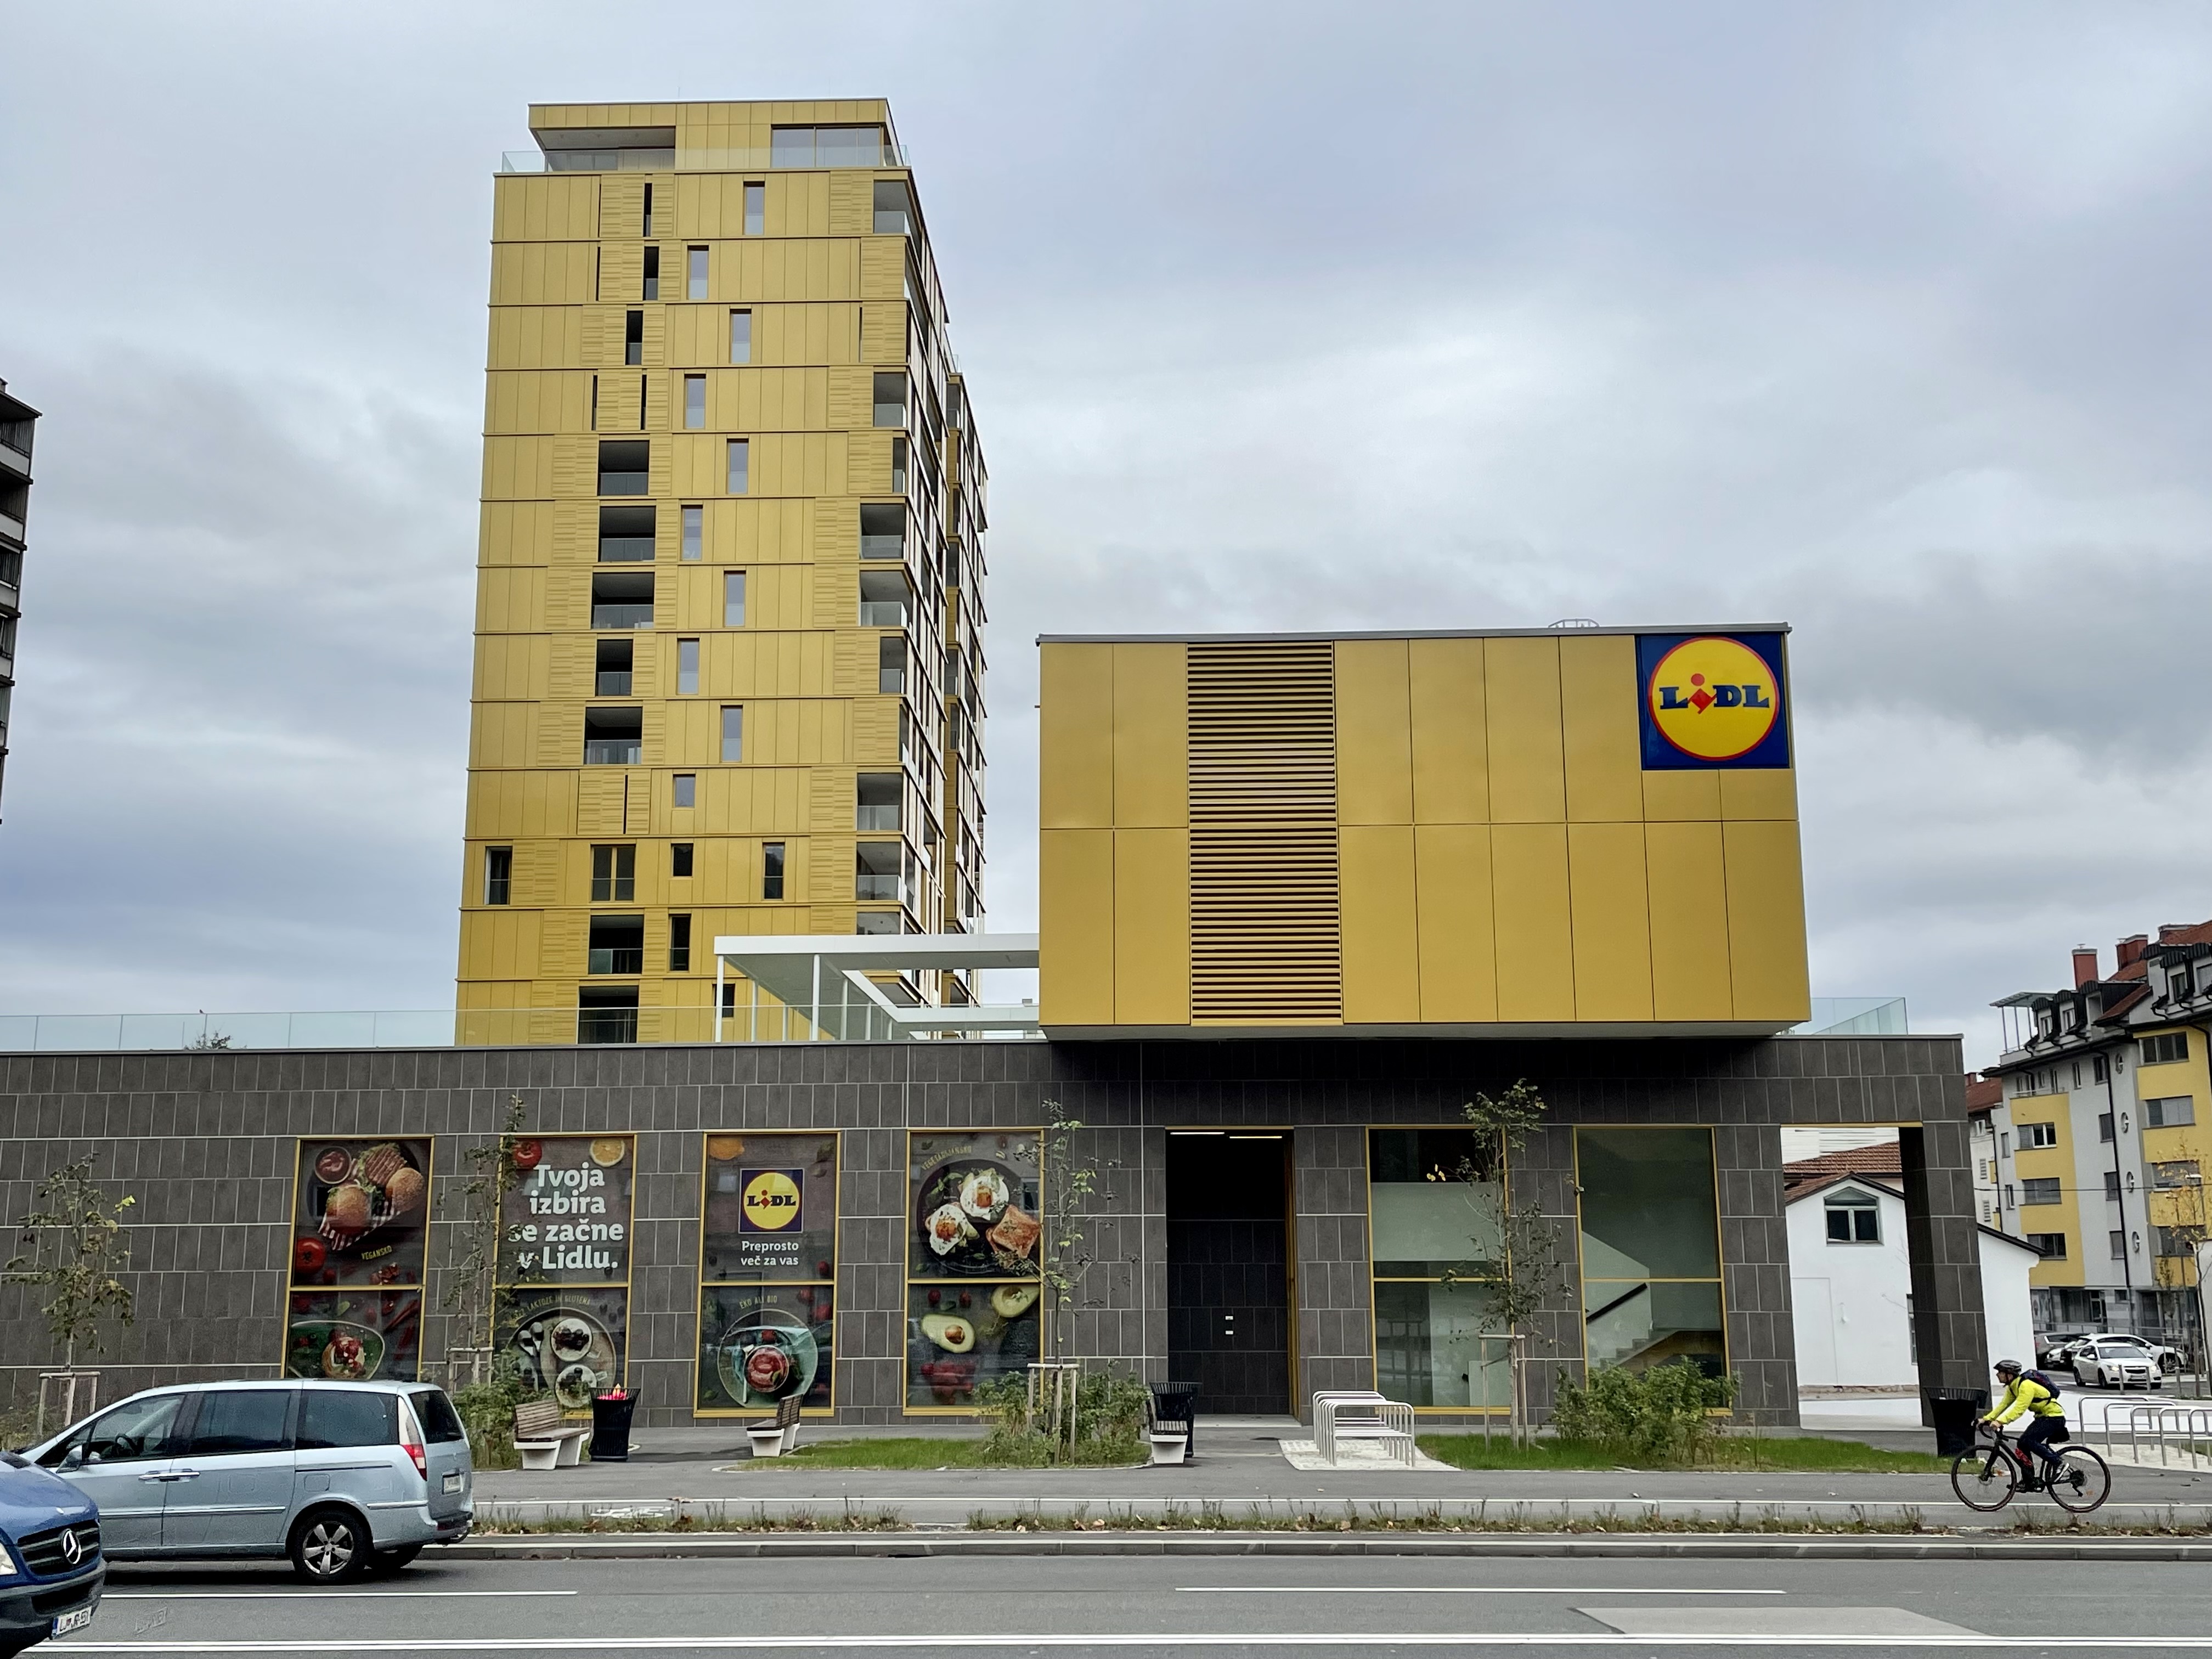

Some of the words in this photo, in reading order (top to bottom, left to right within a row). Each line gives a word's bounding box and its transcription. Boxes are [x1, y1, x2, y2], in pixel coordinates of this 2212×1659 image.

[533, 1161, 605, 1193] Tvoja
[529, 1189, 606, 1214] izbira
[545, 1218, 624, 1242] začne
[362, 1245, 392, 1260] VEGANSKO
[741, 1240, 799, 1254] Preprosto
[518, 1252, 535, 1269] v
[542, 1244, 618, 1269] Lidlu.
[741, 1255, 761, 1266] več
[764, 1257, 776, 1266] za
[780, 1257, 799, 1266] vas
[527, 1295, 554, 1311] LAKTOZE
[565, 1295, 590, 1306] GLUTENA
[739, 1299, 752, 1310] EKO
[767, 1295, 777, 1304] BIO
